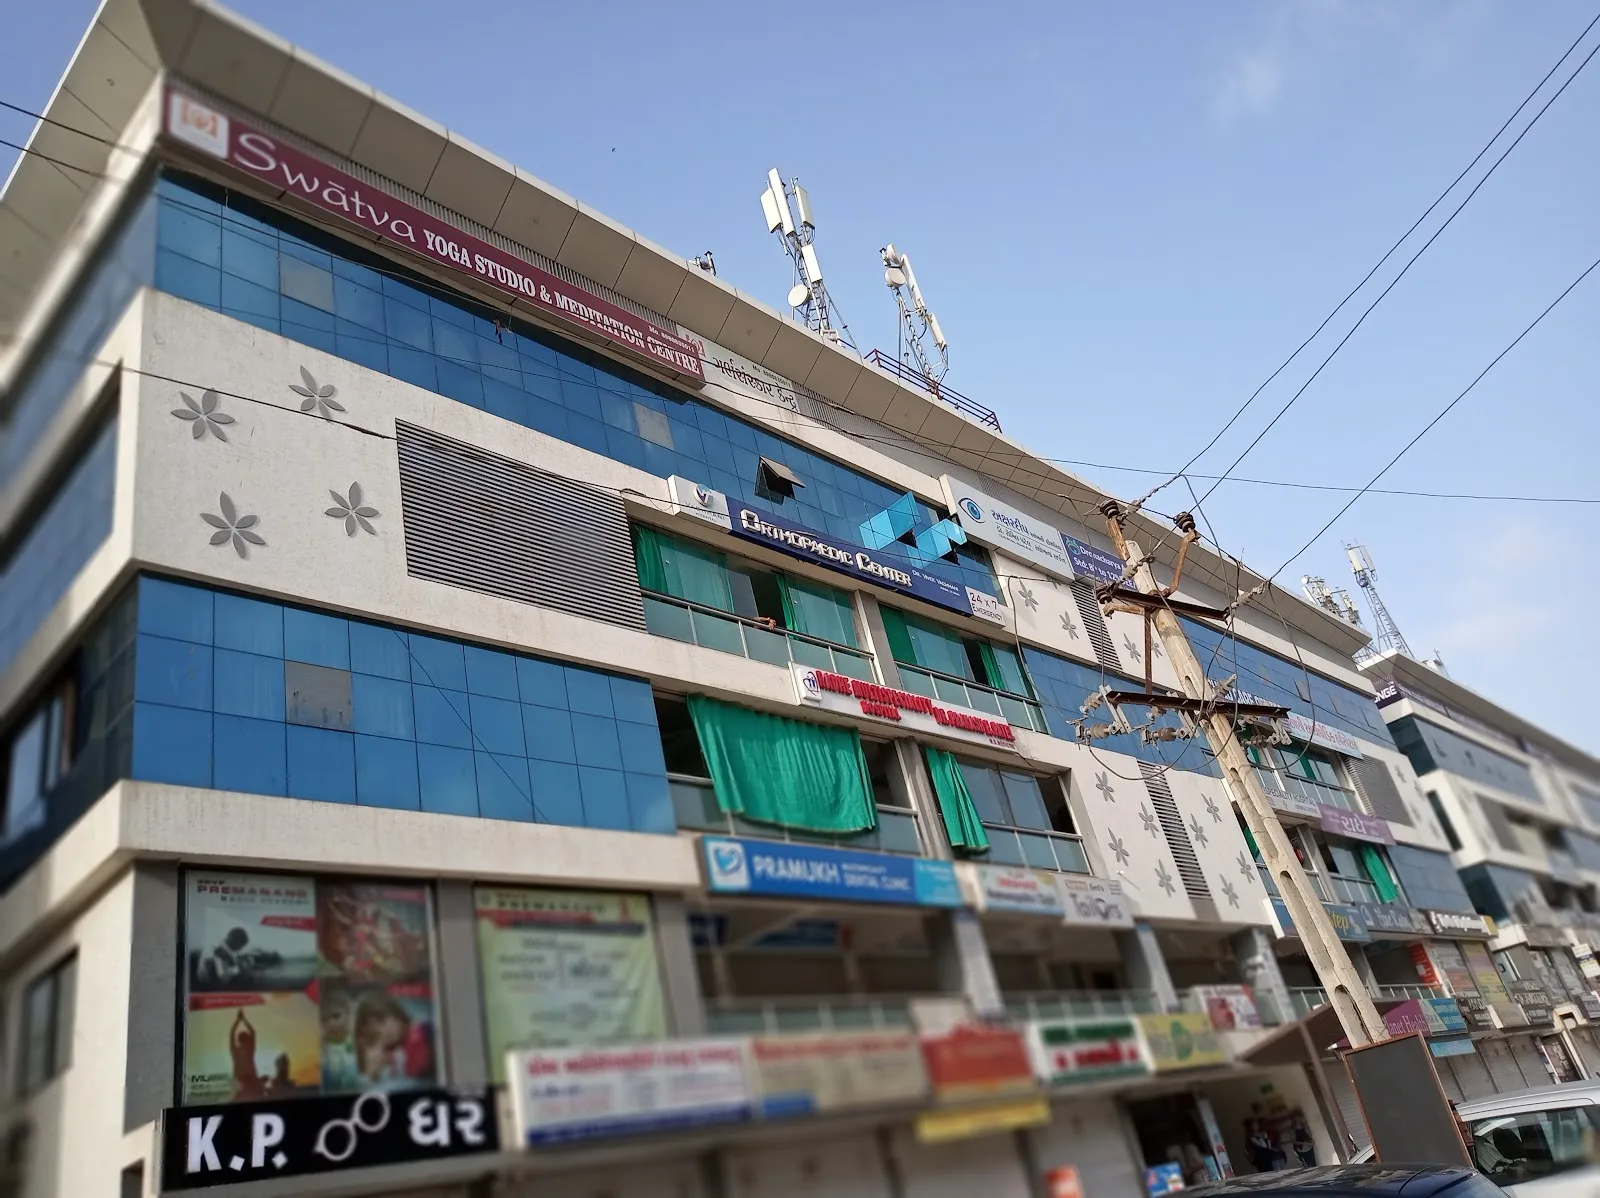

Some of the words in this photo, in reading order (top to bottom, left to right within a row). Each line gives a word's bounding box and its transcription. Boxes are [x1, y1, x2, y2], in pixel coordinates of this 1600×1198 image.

[423, 229, 473, 268] YOGA
[474, 254, 536, 298] STUDIO
[540, 284, 553, 305] &
[553, 290, 645, 349] MEDITATION
[646, 336, 700, 375] CENTRE
[969, 592, 982, 605] 24
[991, 599, 997, 610] 7
[753, 854, 842, 885] PRAMUKH
[407, 1099, 486, 1148] ઘર
